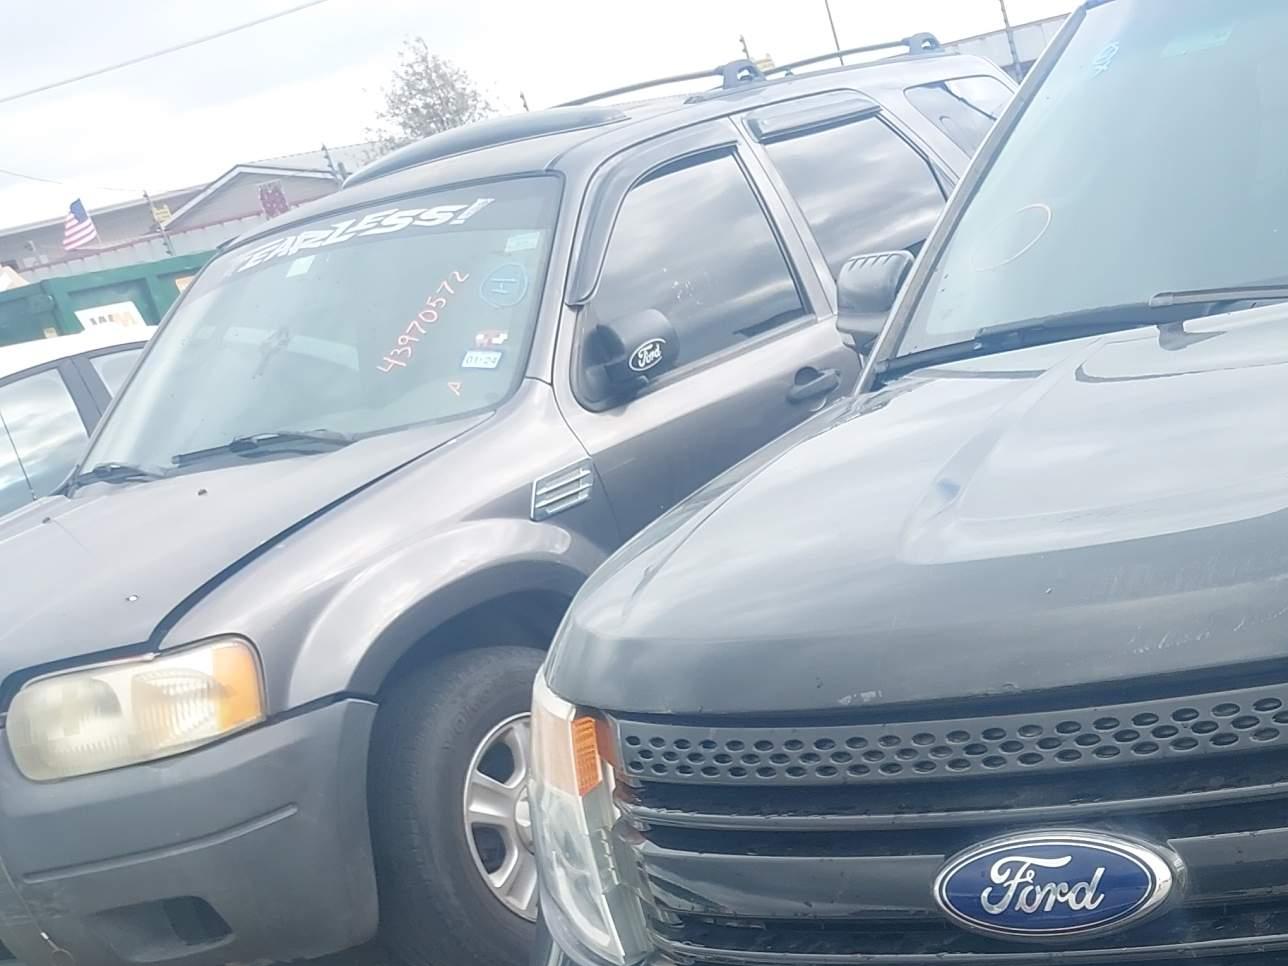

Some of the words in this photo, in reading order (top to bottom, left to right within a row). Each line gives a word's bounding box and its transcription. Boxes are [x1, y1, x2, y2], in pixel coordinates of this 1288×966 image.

[376, 271, 470, 372] 43970572
[638, 343, 662, 367] Ford
[981, 856, 1105, 914] Ford
